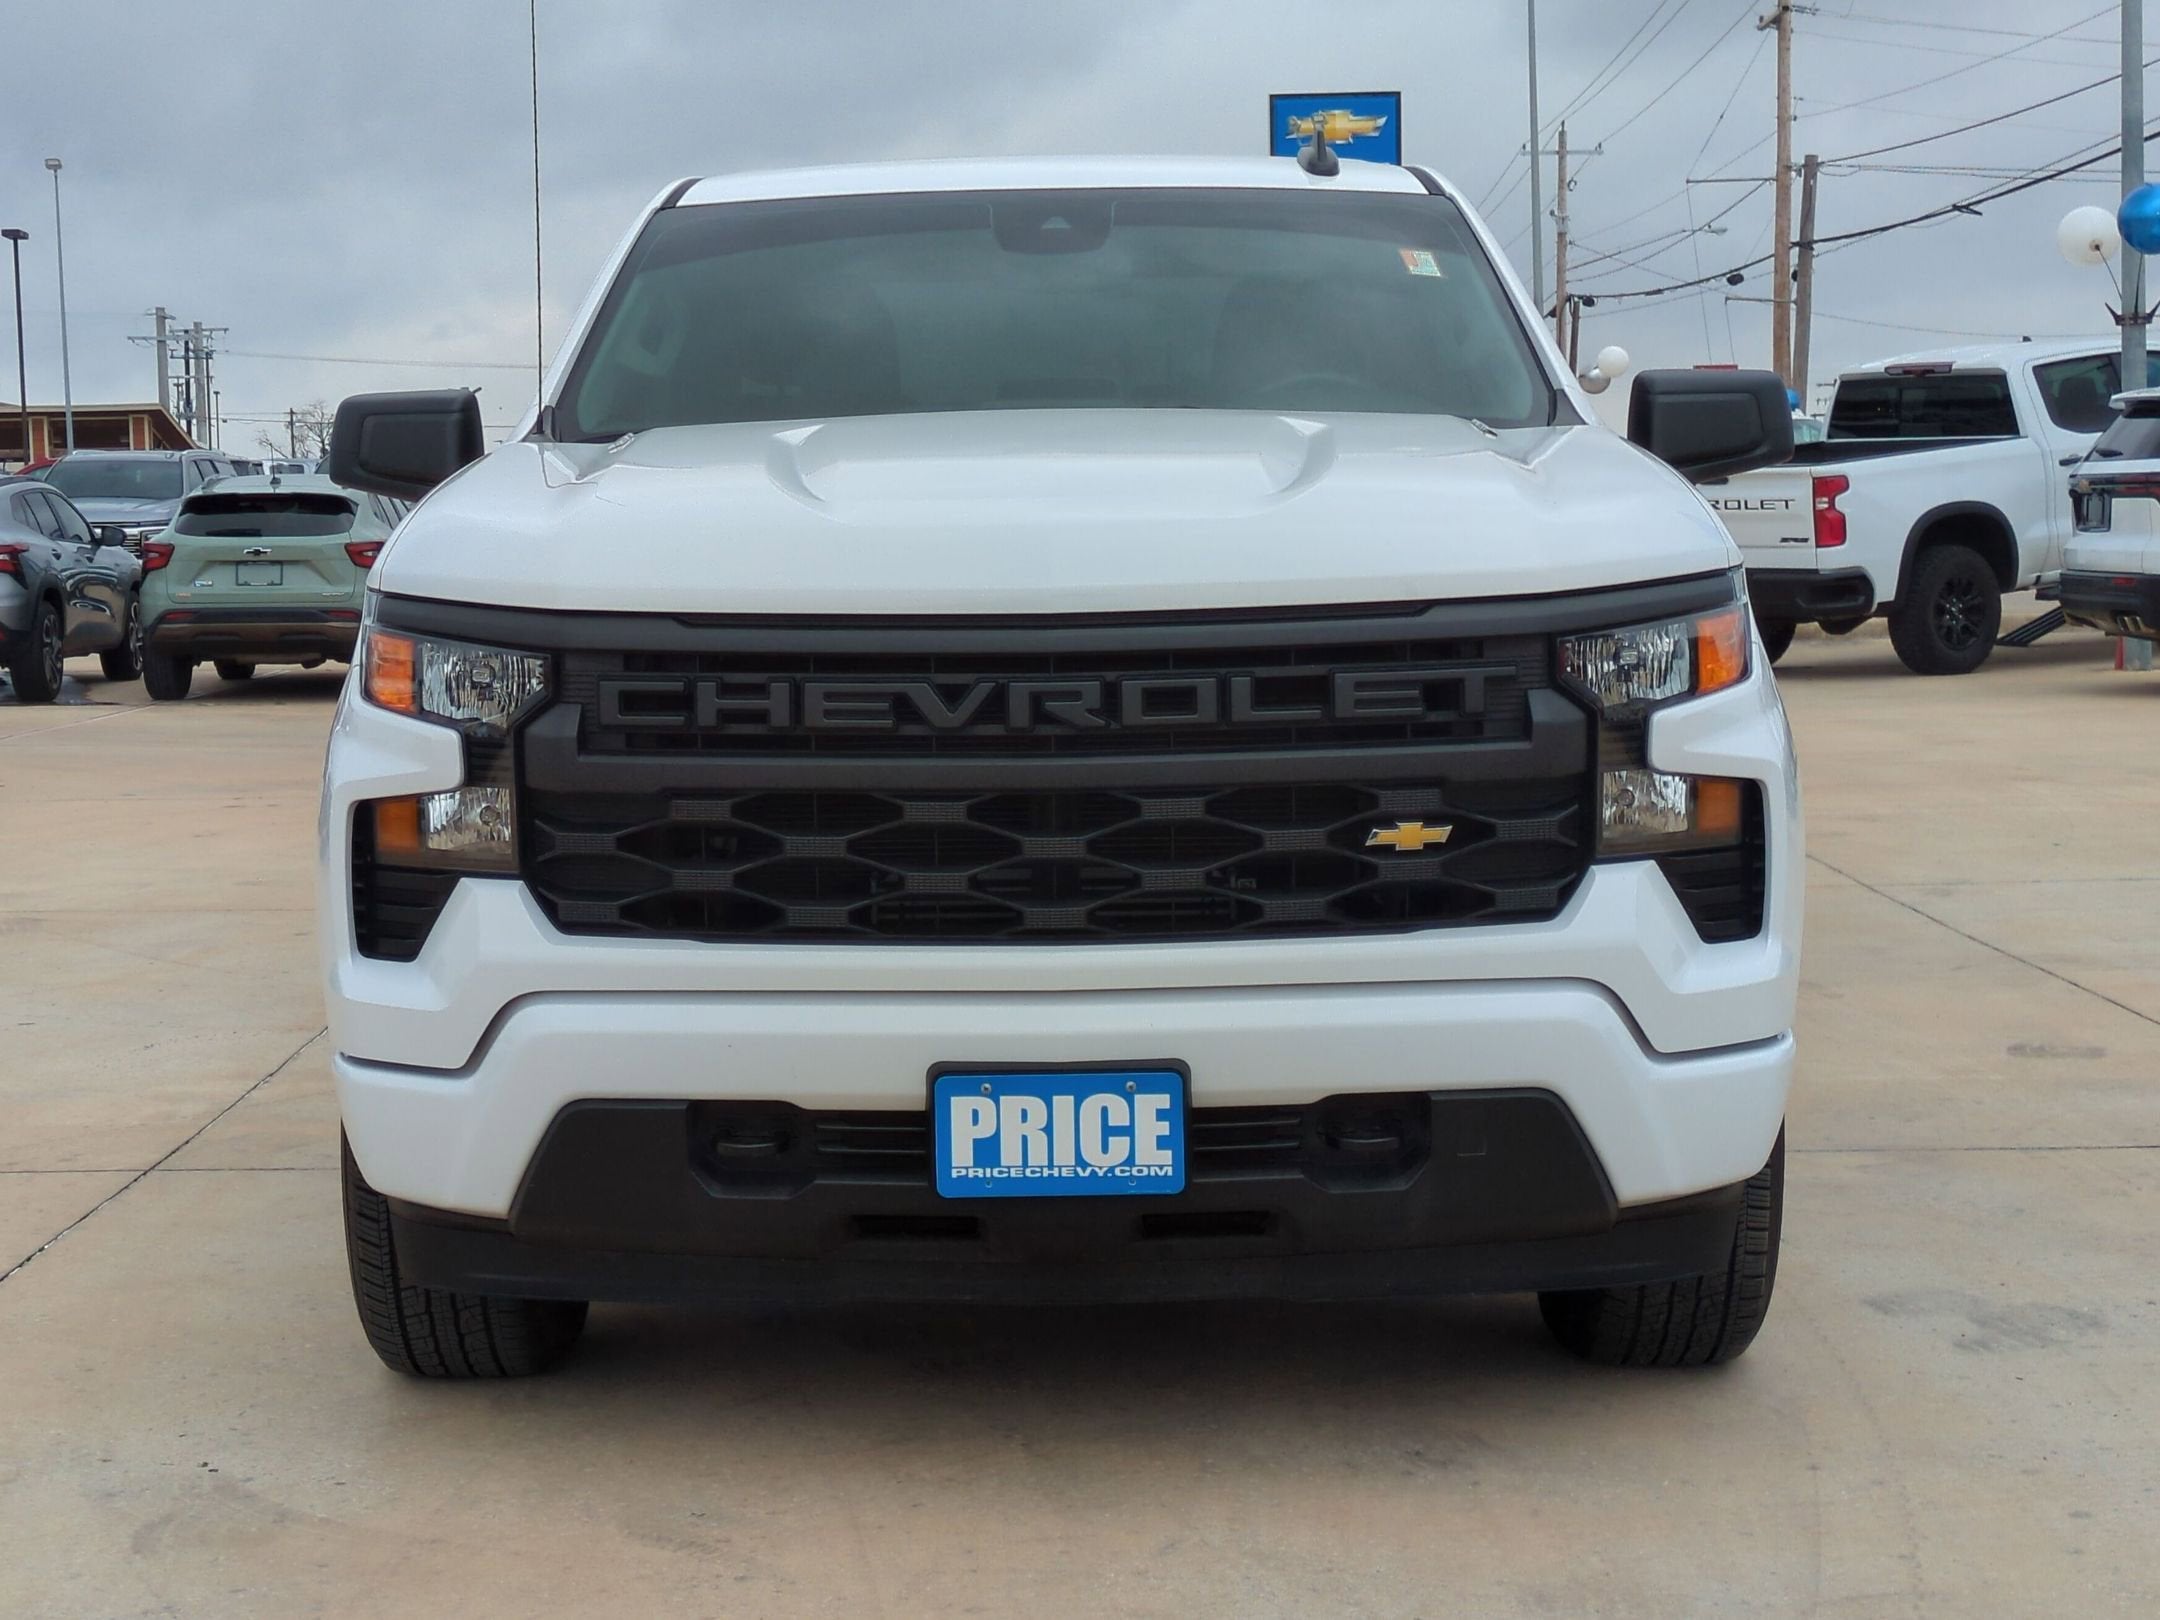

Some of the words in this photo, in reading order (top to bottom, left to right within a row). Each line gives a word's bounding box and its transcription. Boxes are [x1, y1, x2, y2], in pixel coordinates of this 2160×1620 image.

[598, 664, 1518, 729] CHEVROLET
[950, 1093, 1172, 1167] PRICE
[951, 1166, 1173, 1178] PRICECHEVY.COM
